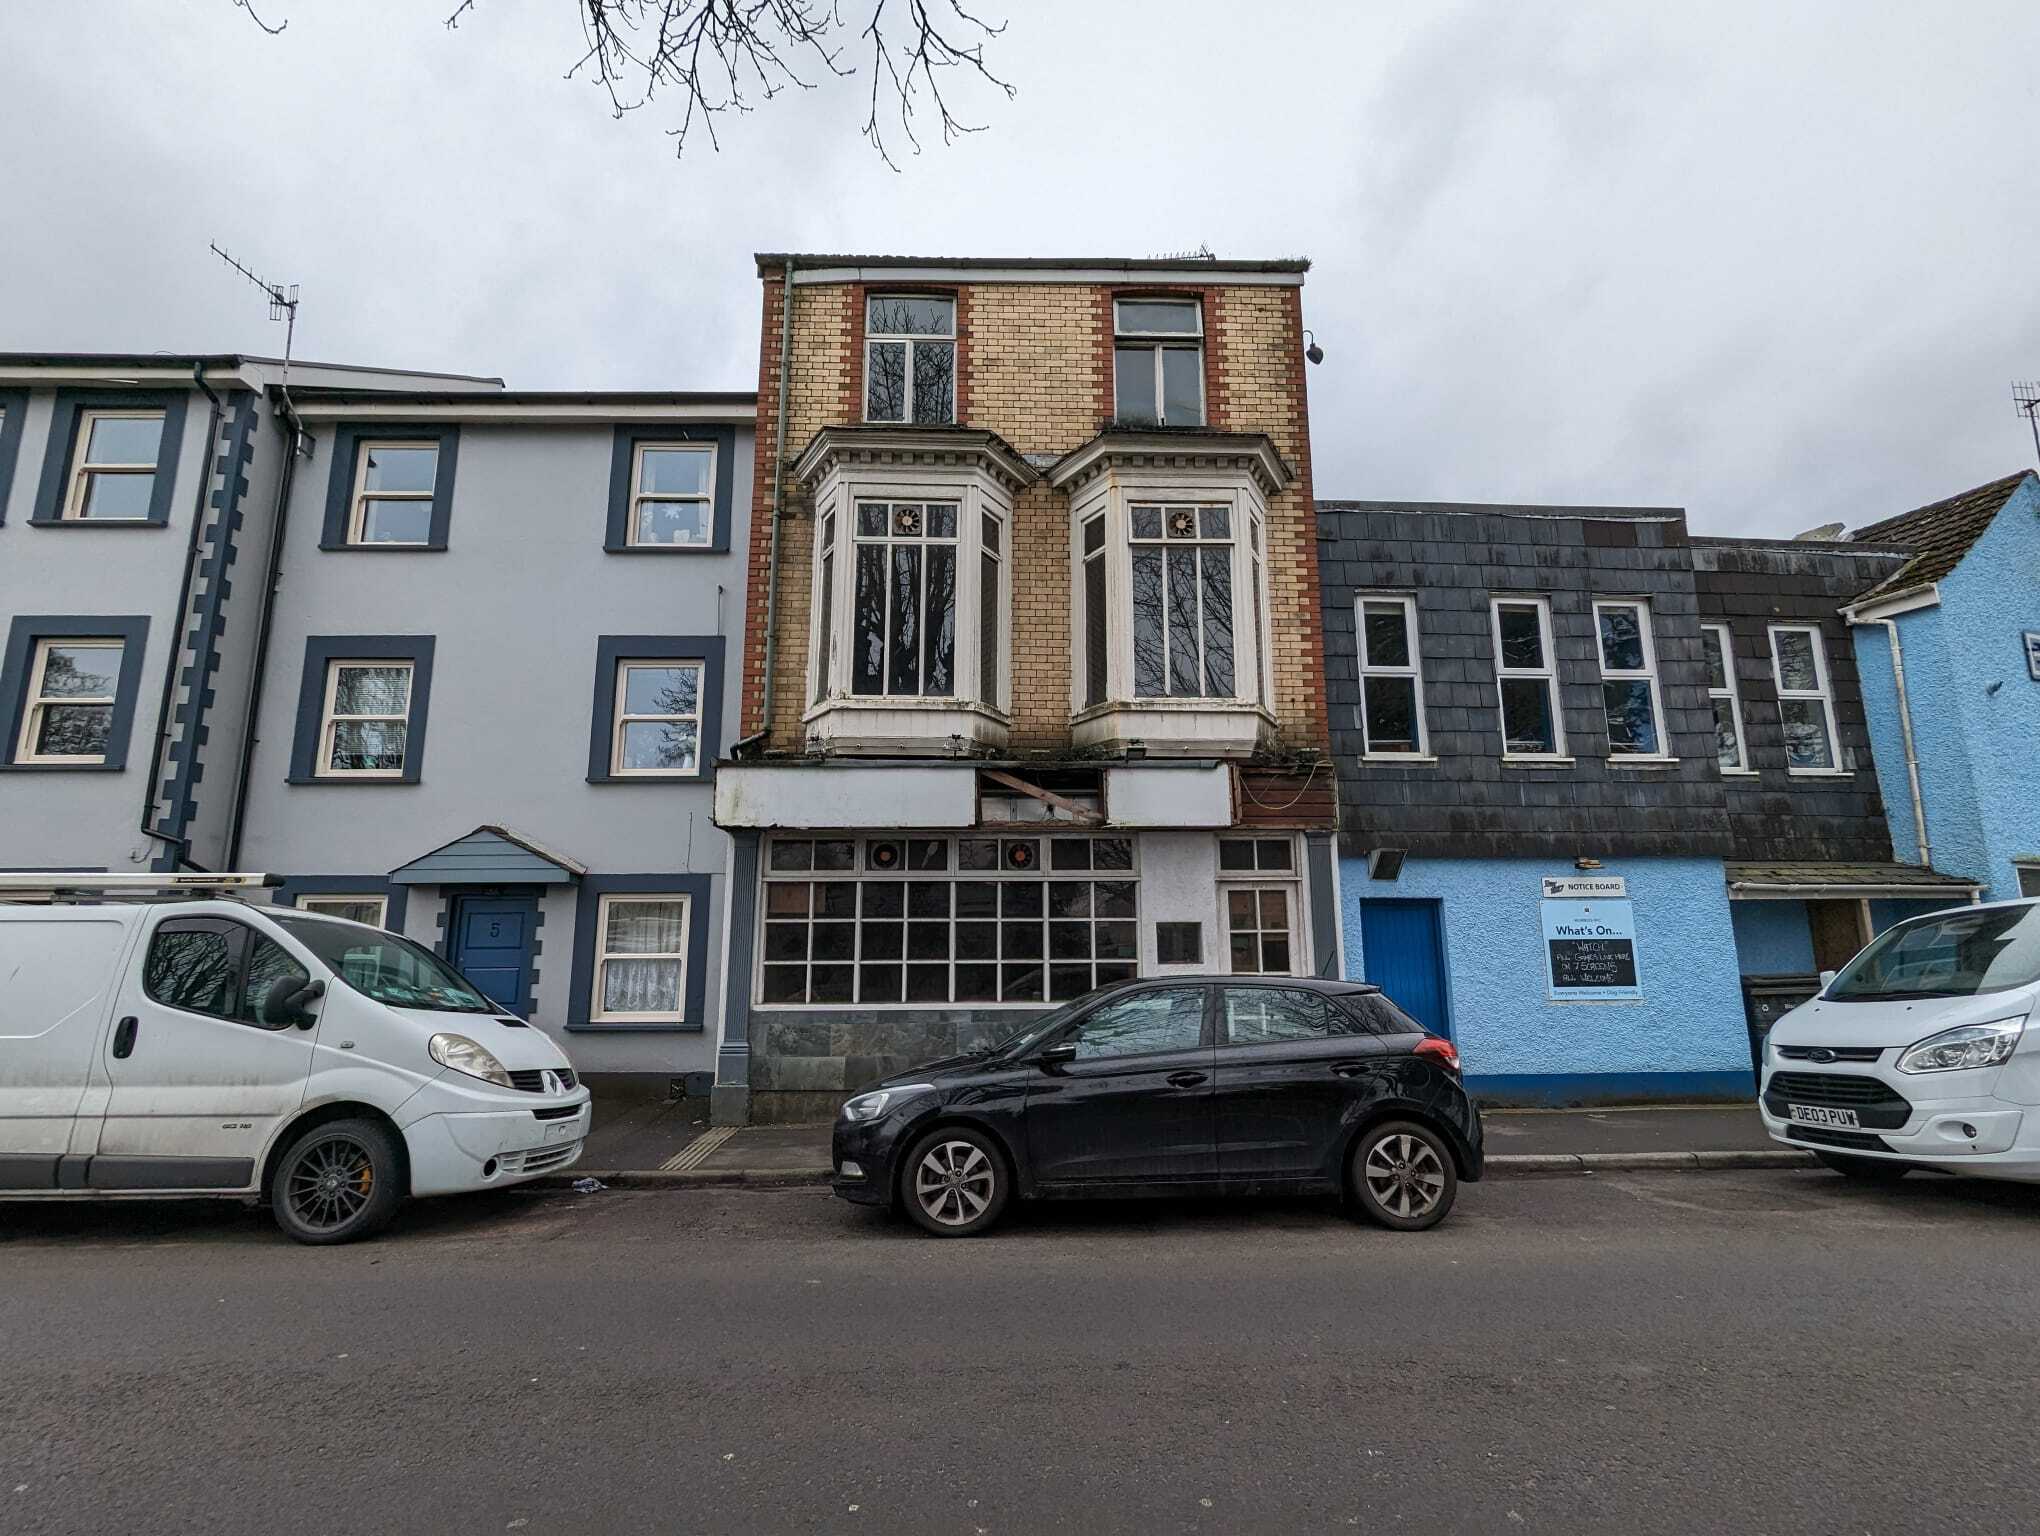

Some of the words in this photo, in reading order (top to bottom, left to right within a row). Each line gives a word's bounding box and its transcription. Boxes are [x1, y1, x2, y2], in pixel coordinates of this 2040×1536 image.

[490, 922, 501, 938] 5
[1556, 926, 1593, 935] What's
[1596, 925, 1622, 935] On...
[1797, 1106, 1828, 1122] DE03
